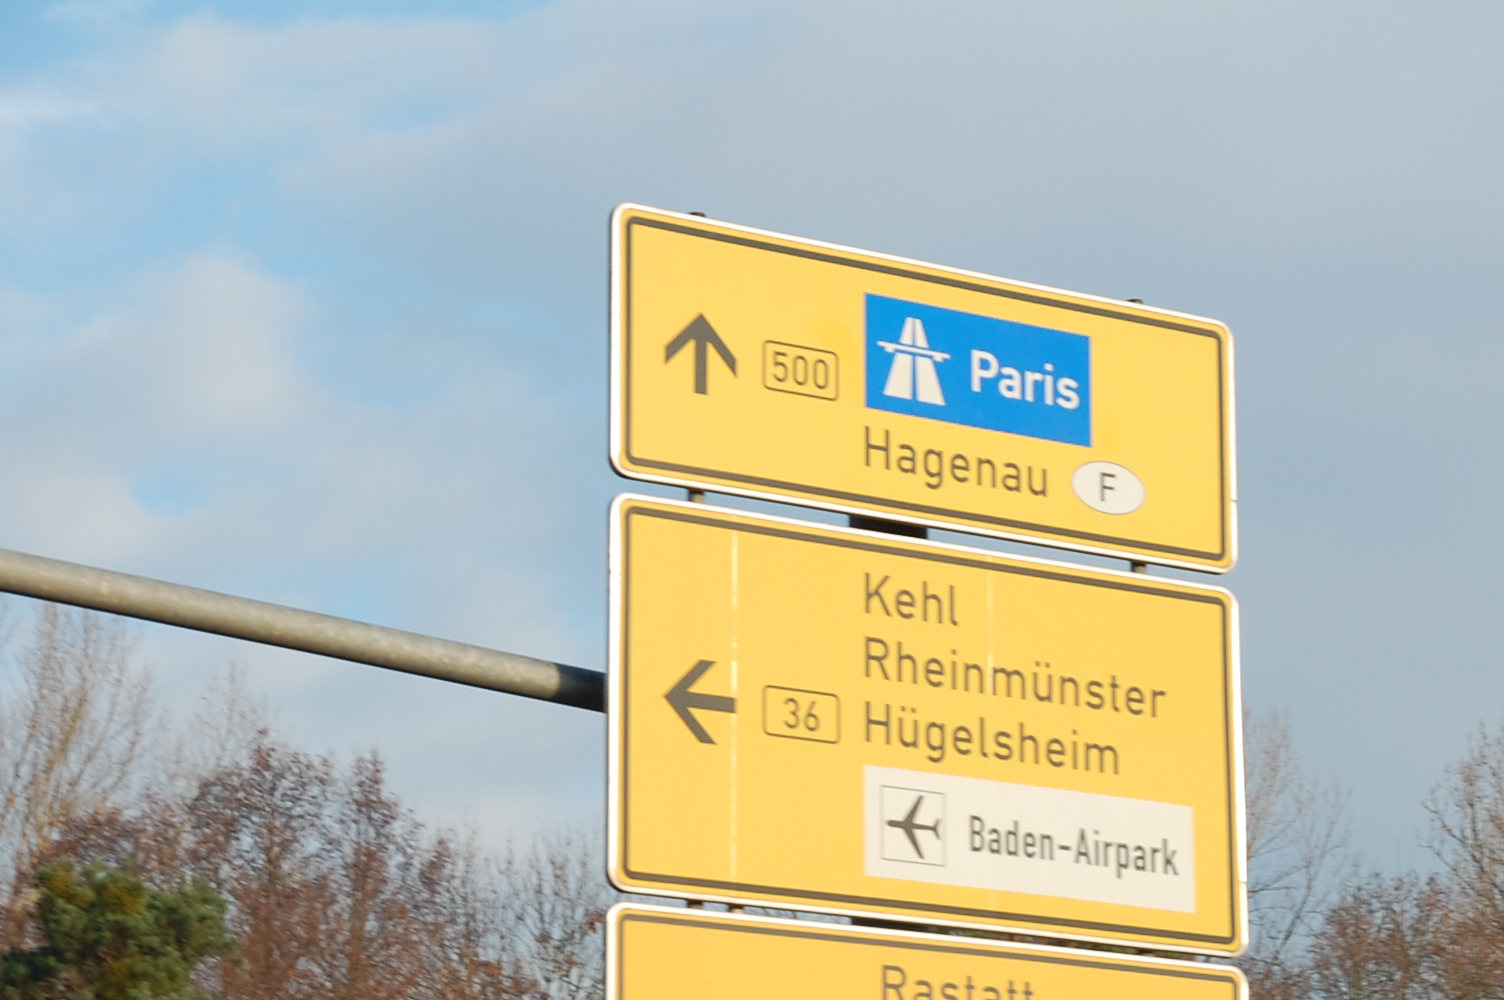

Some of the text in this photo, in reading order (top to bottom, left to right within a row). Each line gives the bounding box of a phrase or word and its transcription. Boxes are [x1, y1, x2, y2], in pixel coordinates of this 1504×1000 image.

[771, 350, 830, 391] 500
[970, 349, 1080, 410] Paris
[863, 426, 1048, 497] Hagenau
[1099, 472, 1116, 502] F
[864, 572, 959, 627] Kehl
[863, 637, 1167, 718] Rheinmünster
[782, 698, 820, 732] 36
[863, 702, 1120, 775] Hügelsheim
[969, 815, 1180, 878] Baden-Airpark
